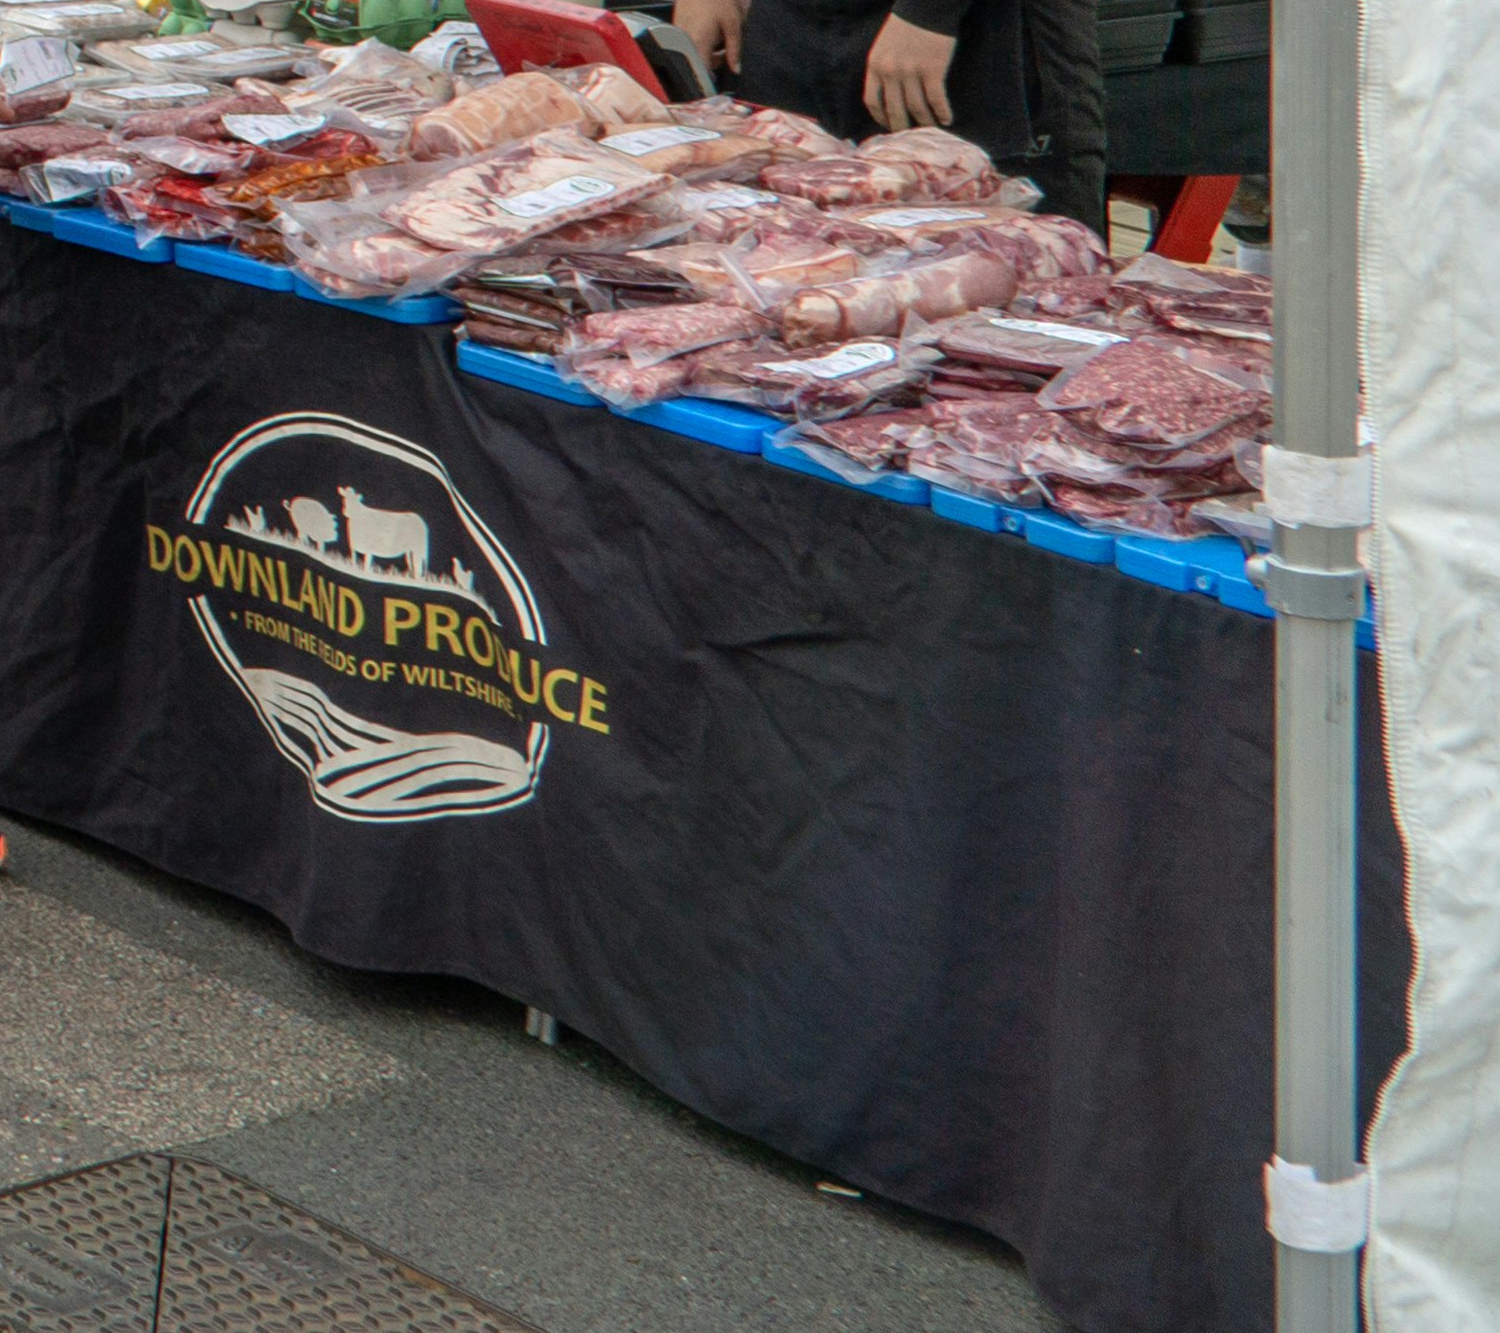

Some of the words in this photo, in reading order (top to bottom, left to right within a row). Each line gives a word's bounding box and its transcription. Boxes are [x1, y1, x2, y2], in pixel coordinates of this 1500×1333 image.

[146, 523, 366, 637] DOWNLAND
[383, 596, 611, 734] PRODUCE
[244, 610, 291, 643] FROM
[292, 628, 318, 653] THE
[361, 659, 396, 682] OF
[402, 663, 515, 713] WILTSHIRE
